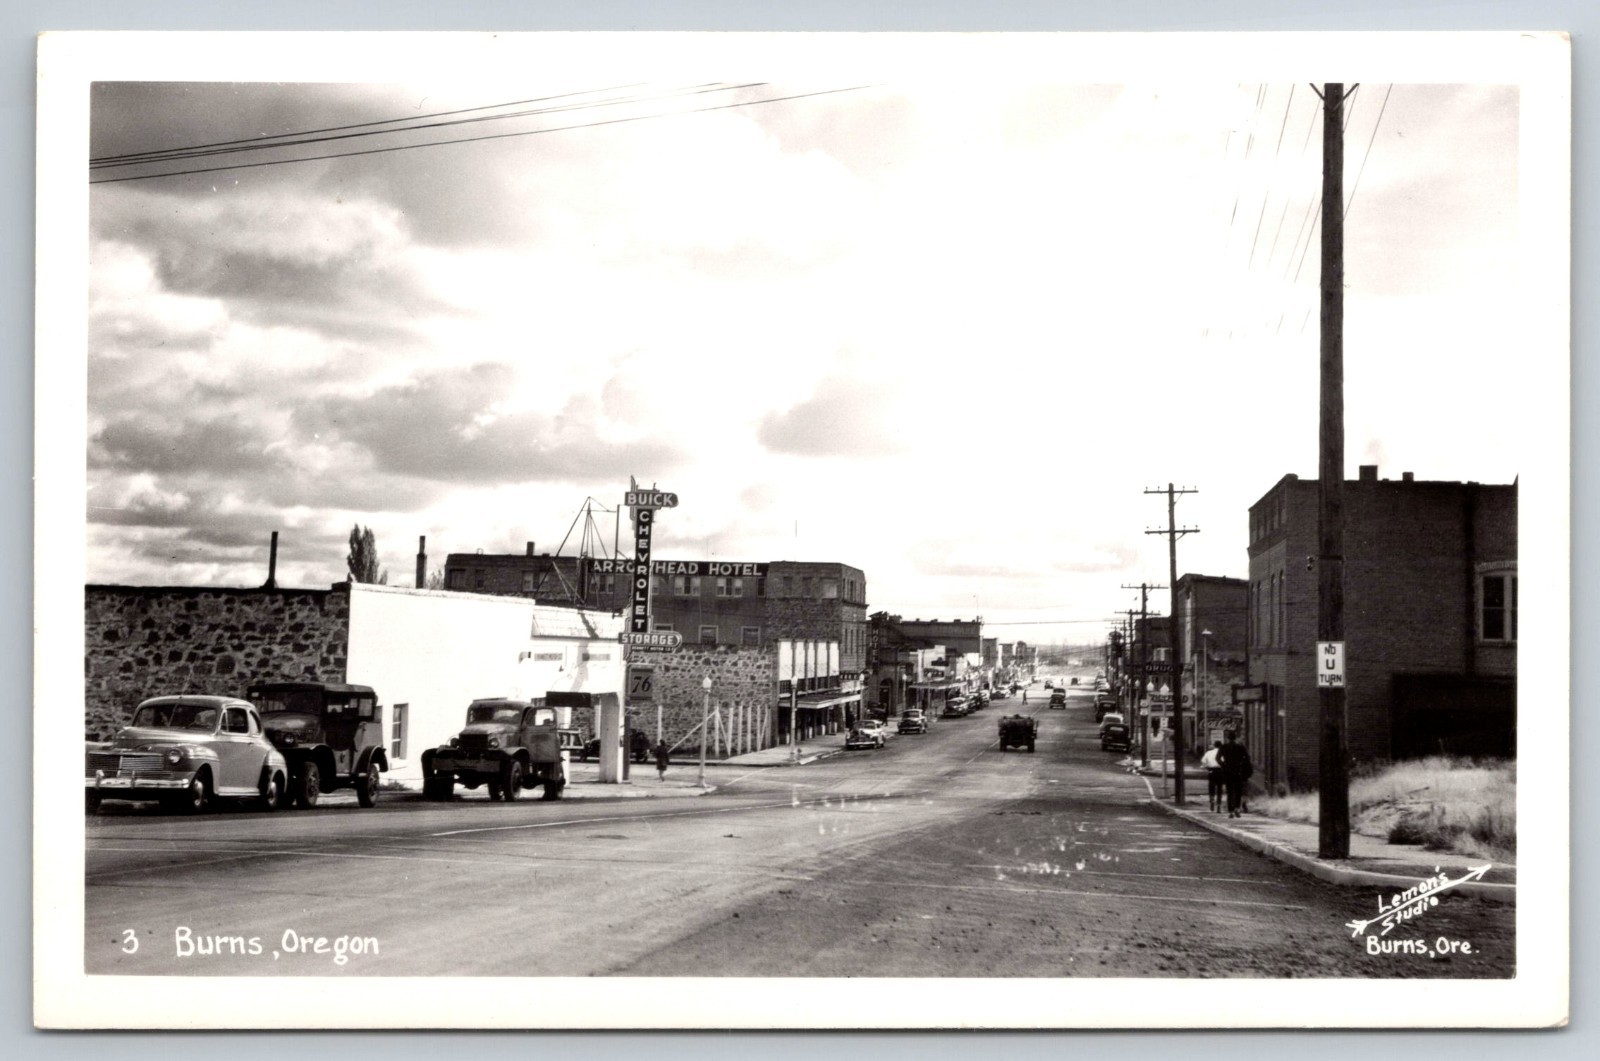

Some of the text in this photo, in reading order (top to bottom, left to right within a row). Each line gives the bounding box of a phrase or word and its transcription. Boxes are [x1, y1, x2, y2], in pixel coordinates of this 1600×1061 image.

[627, 493, 673, 506] BUICK
[593, 560, 762, 576] ARROHEAD HOTEL
[635, 511, 650, 629] CHEVROLET
[621, 633, 674, 645] STORAGE
[1324, 646, 1336, 655] NO
[1326, 659, 1335, 670] U
[631, 675, 652, 693] 76
[1320, 674, 1342, 683] TURN
